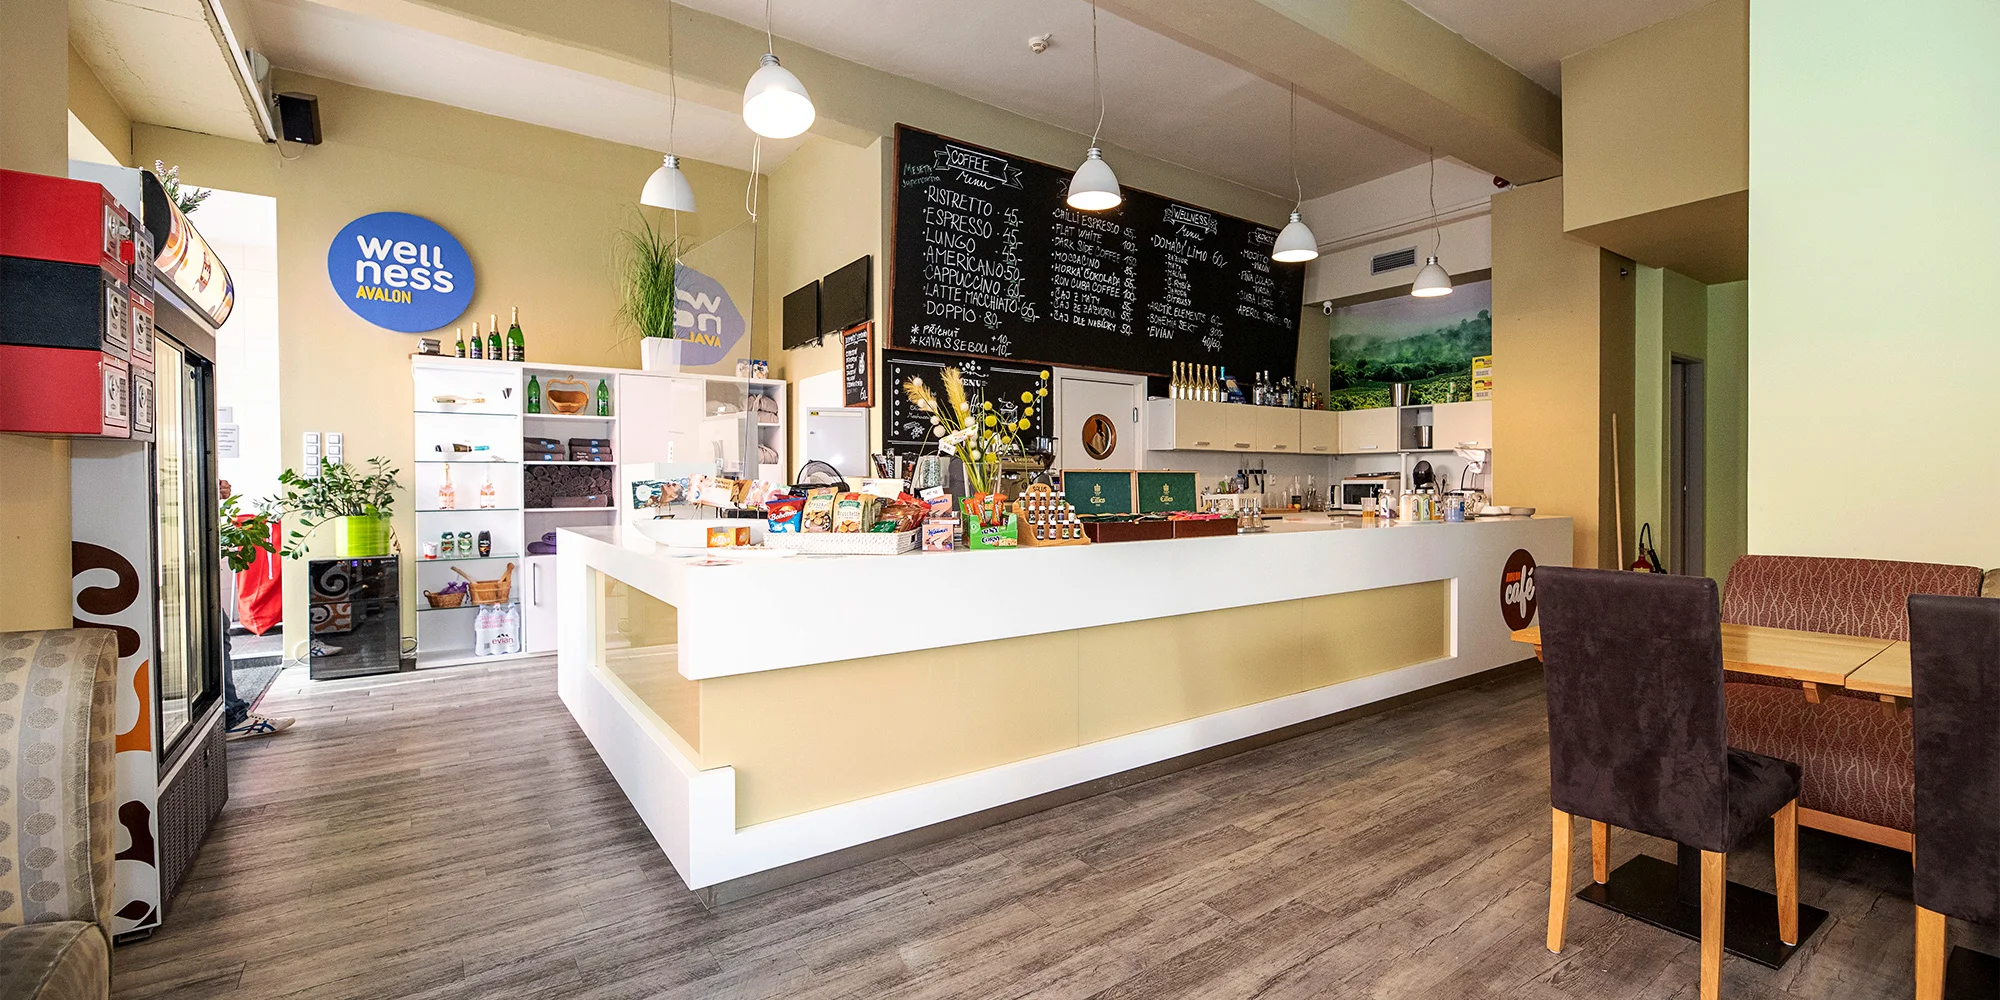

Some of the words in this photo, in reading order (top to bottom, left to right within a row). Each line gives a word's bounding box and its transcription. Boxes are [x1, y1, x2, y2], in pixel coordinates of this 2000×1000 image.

[951, 150, 989, 172] COFFEE
[956, 171, 995, 190] Menu
[927, 185, 993, 217] RISTRETTO
[925, 206, 993, 239] ESPRESSO
[1081, 215, 1120, 235] ESPRESSO
[1173, 207, 1209, 226] WELLNESS
[925, 227, 976, 253] LUNGO
[1055, 223, 1075, 236] FLAT
[1078, 228, 1102, 244] WHITE
[357, 235, 444, 269] well
[1054, 236, 1075, 251] DARK
[1077, 240, 1094, 255] SIDE
[1095, 246, 1121, 264] COFFEE
[1187, 245, 1208, 262] LIMO
[926, 245, 1004, 278] AMERICANO
[356, 260, 454, 293] ness
[925, 264, 1001, 295] CAPPUCCINO
[356, 285, 411, 304] AVALON
[925, 283, 962, 301] LATTE
[965, 291, 1018, 313] MACCHIATO
[1071, 278, 1091, 291] CUBA
[1092, 282, 1121, 298] COFFEE
[926, 300, 977, 323] DOPPIO
[1174, 307, 1206, 323] ELEMENTS
[1149, 326, 1174, 339] EVIAN
[952, 338, 988, 354] SEBOU
[1505, 565, 1535, 618] café
